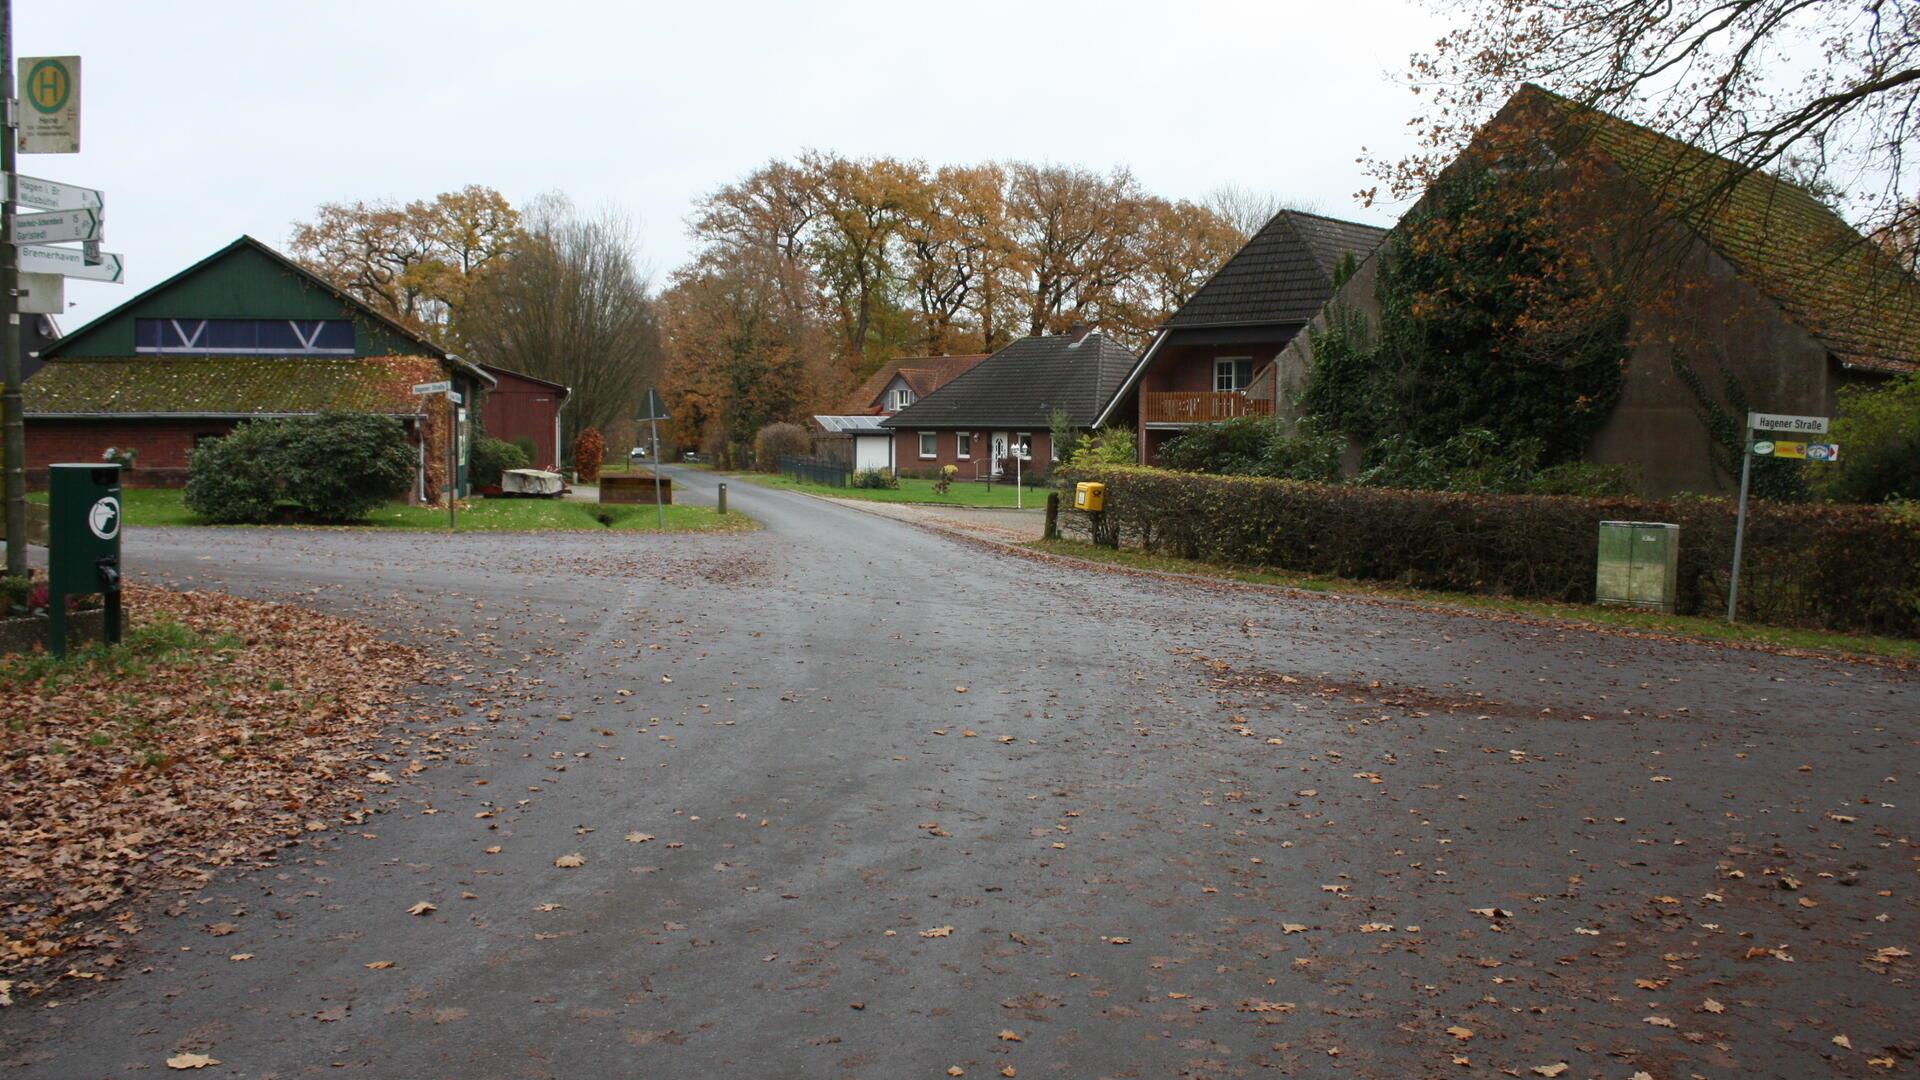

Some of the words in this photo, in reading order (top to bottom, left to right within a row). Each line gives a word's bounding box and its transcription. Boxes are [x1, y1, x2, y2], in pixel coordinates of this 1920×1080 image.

[40, 71, 58, 102] H
[19, 181, 43, 193] Hagen
[22, 247, 80, 262] Bremerhaven
[1760, 417, 1792, 430] Hagener
[1795, 418, 1822, 431] Straße
